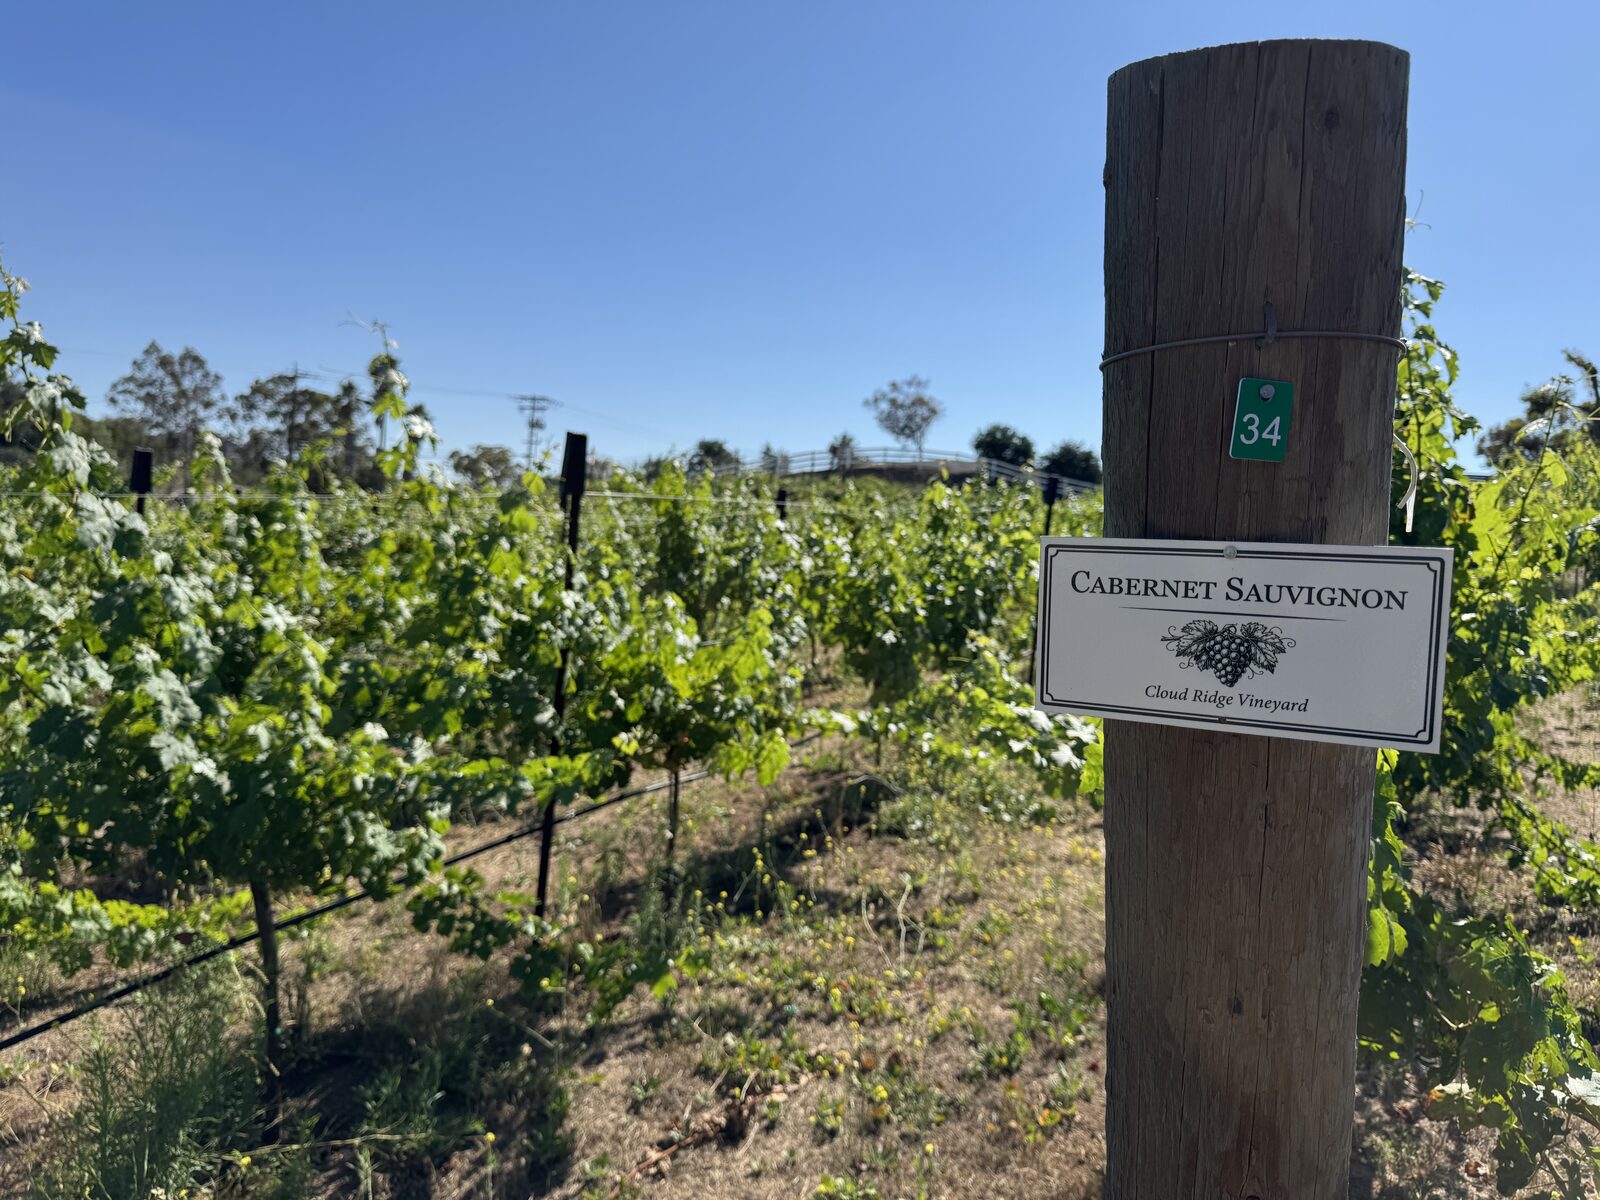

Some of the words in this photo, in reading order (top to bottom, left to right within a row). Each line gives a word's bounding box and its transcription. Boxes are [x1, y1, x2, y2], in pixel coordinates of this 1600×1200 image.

[1239, 413, 1282, 447] 34
[1070, 569, 1218, 601] CABERNET
[1224, 576, 1409, 611] SAUVIGNON
[1144, 684, 1189, 702] Cloud
[1191, 688, 1234, 707] Ridge
[1238, 692, 1309, 713] Vineyard
